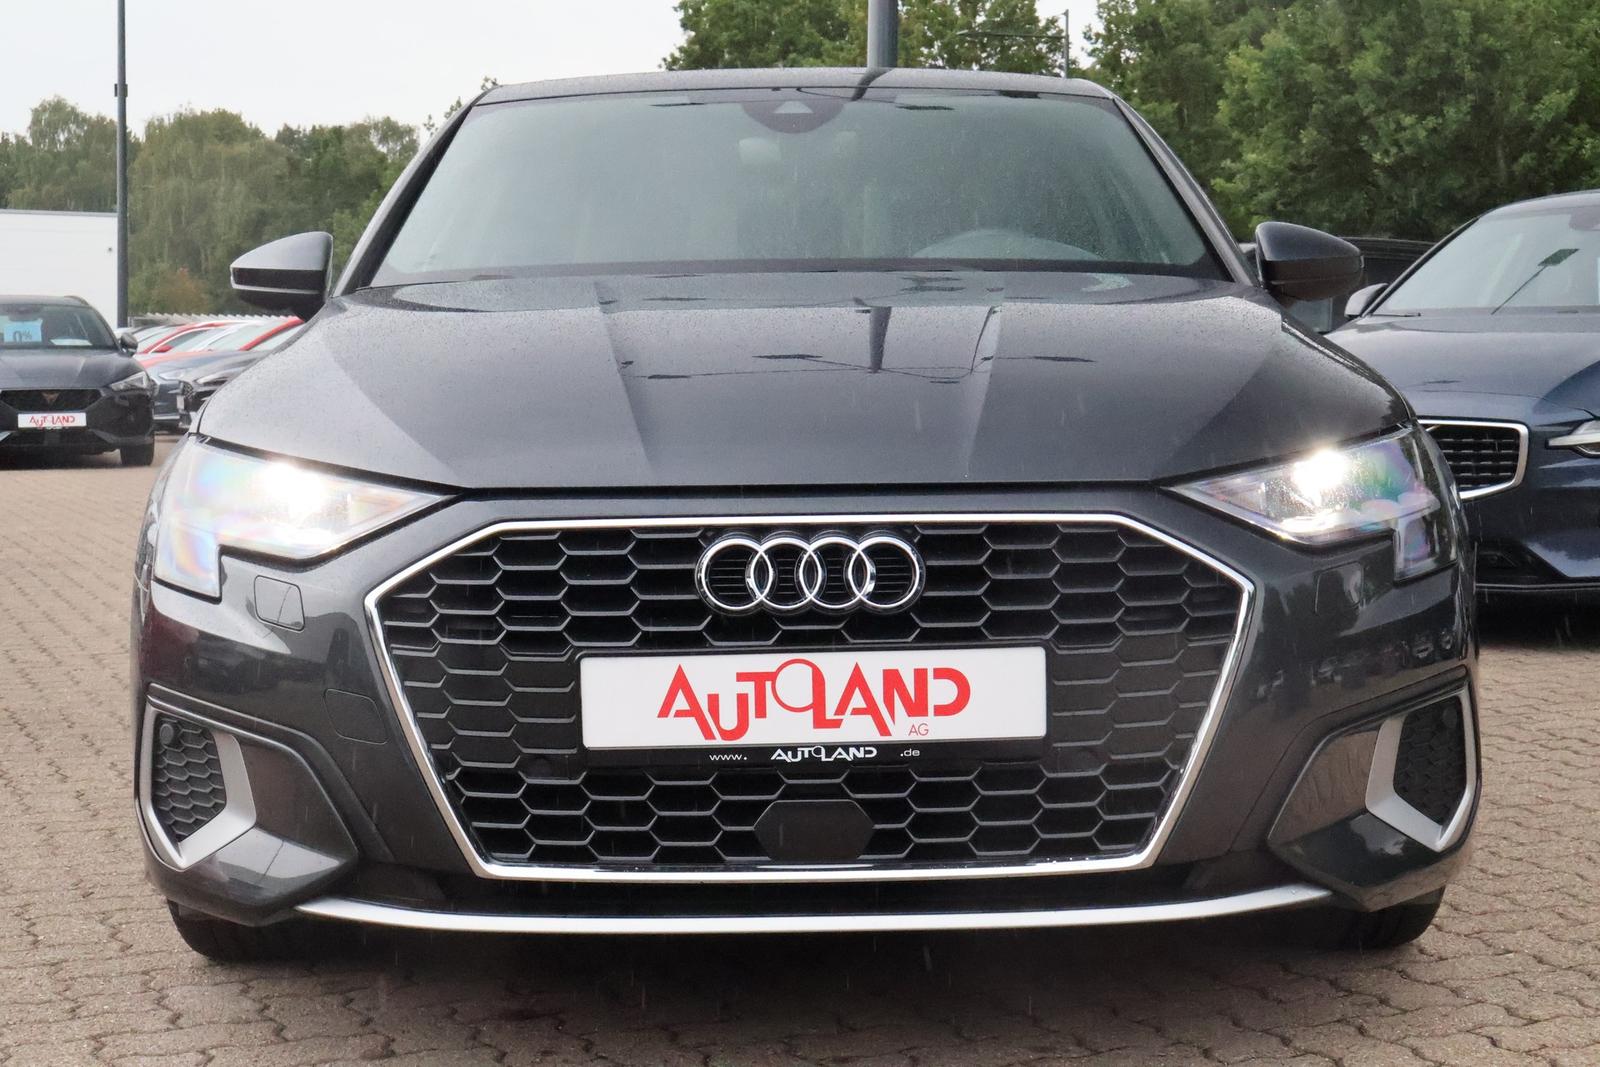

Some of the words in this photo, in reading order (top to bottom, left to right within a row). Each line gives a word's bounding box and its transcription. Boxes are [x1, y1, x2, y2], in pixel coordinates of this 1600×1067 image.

[658, 658, 971, 742] AUTOLAND
[908, 723, 929, 737] AG
[709, 753, 748, 761] www.
[771, 745, 878, 763] AUTOLAND
[900, 748, 921, 758] .de
